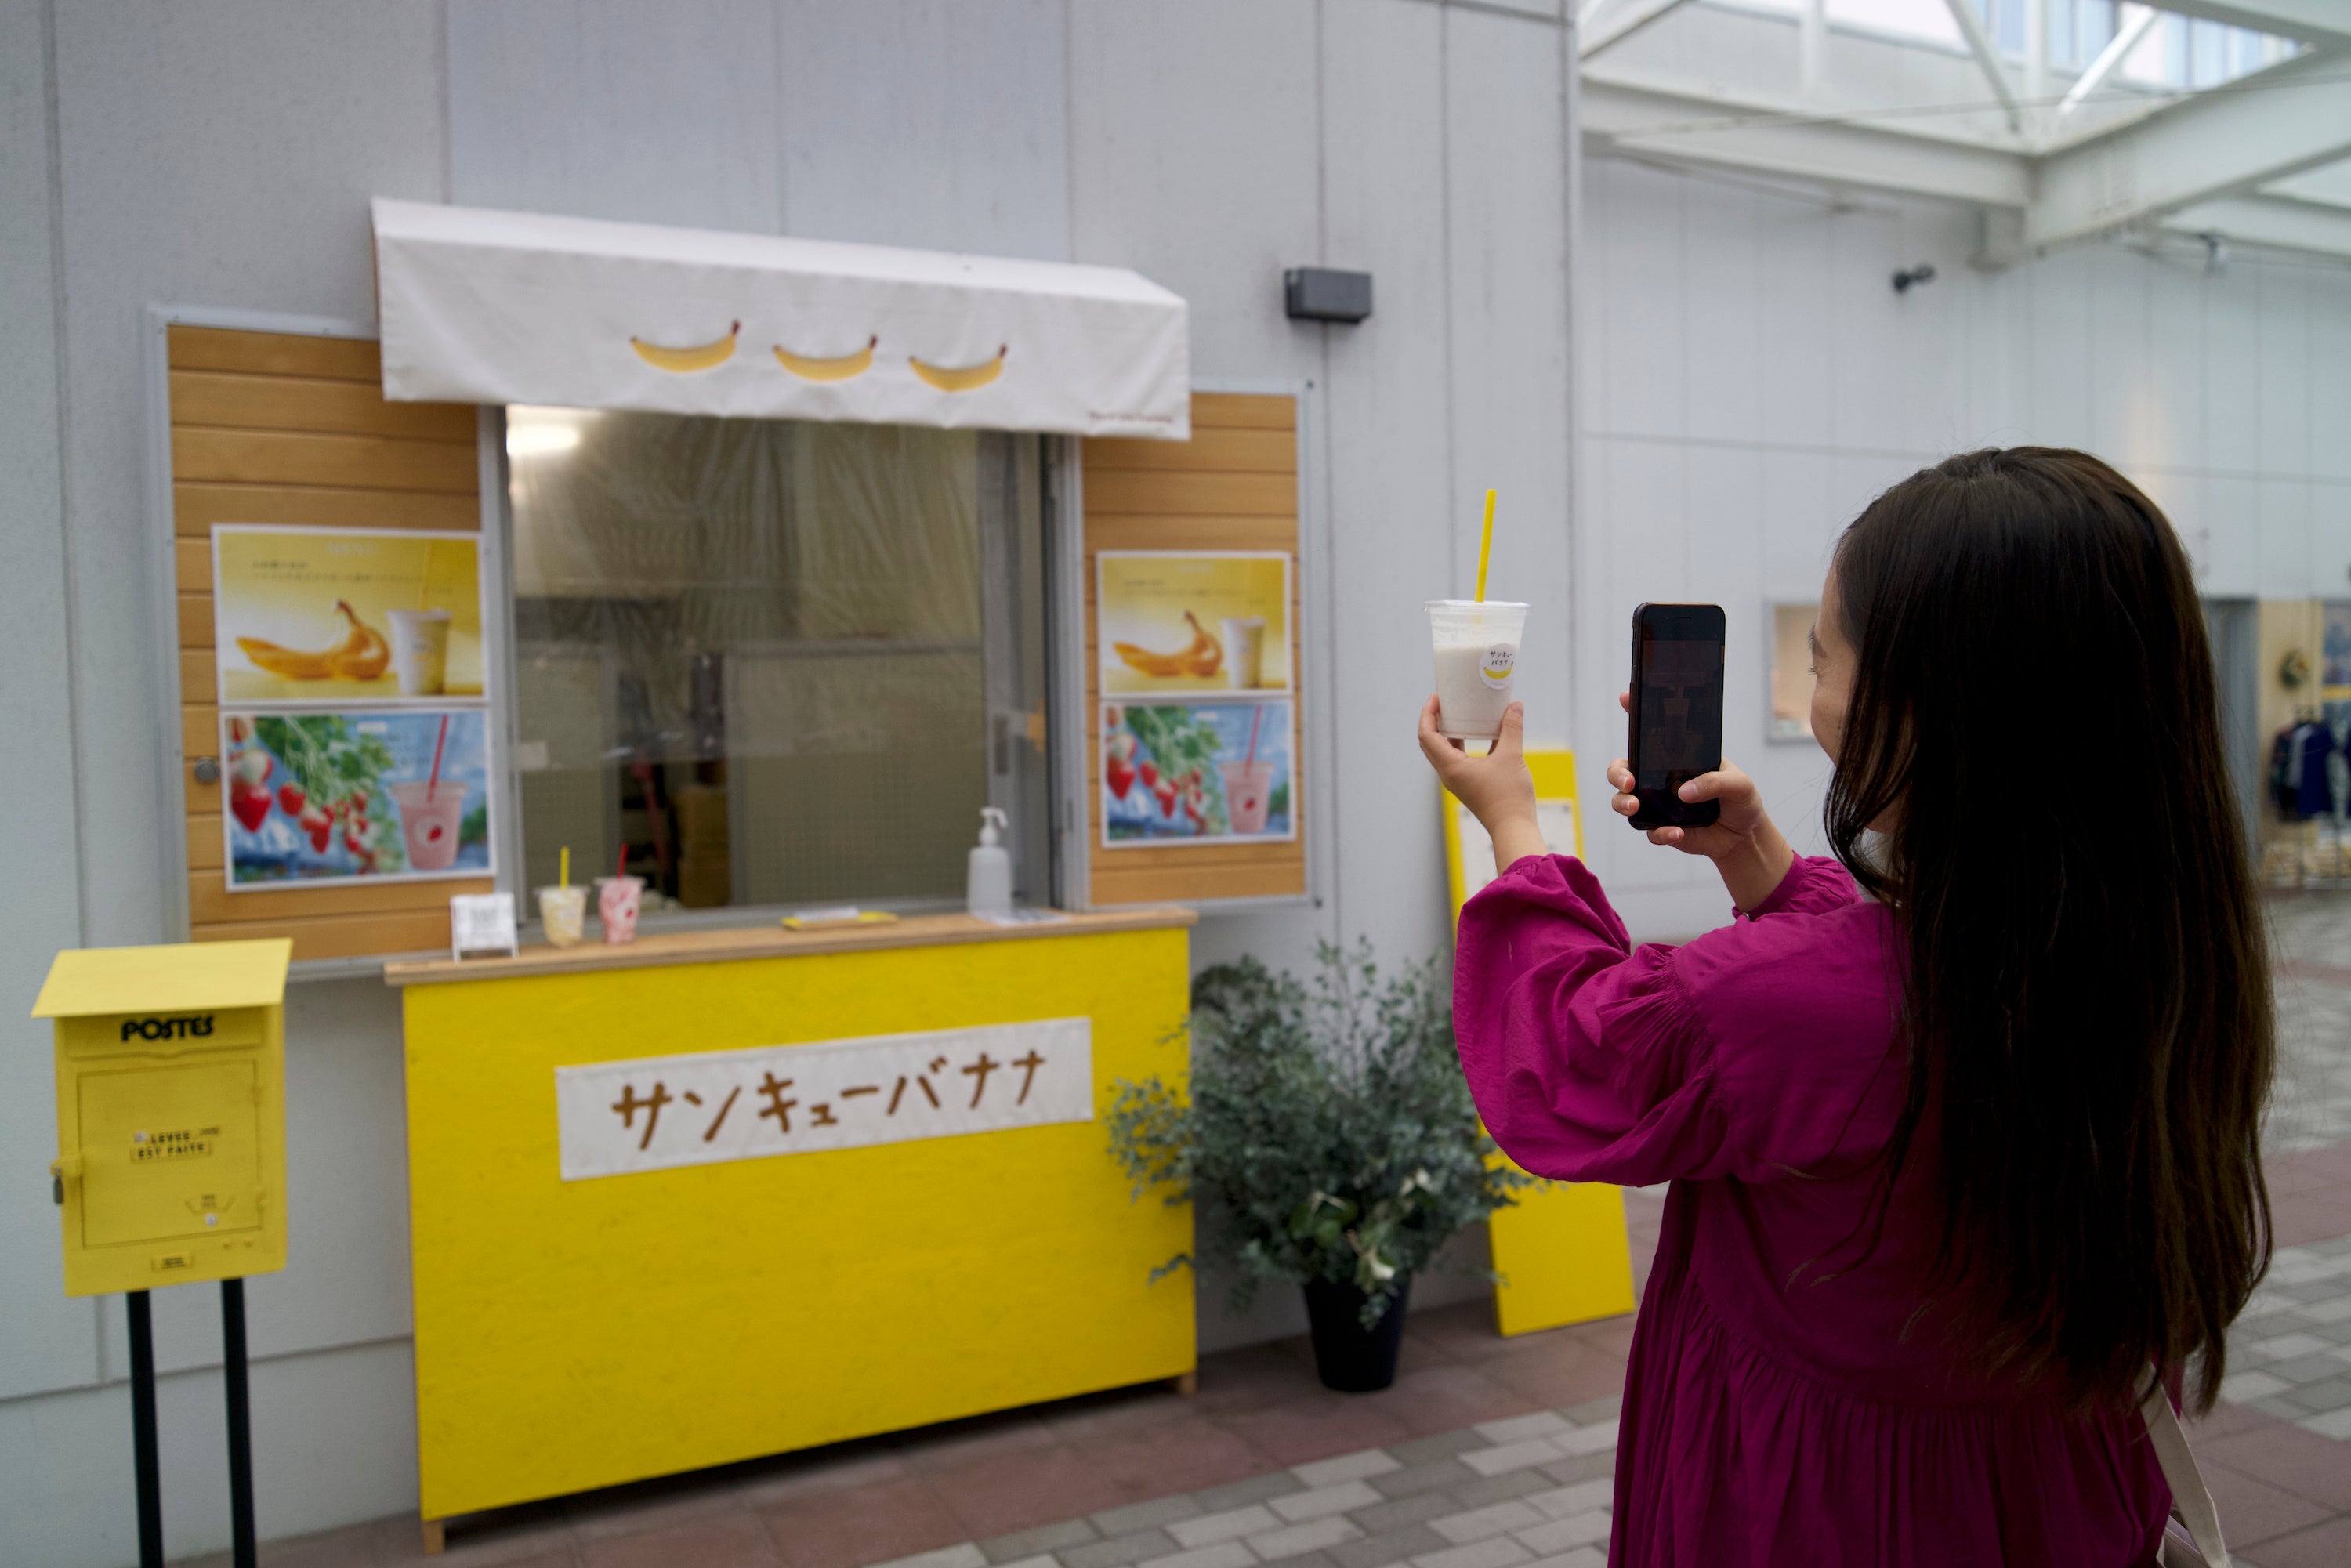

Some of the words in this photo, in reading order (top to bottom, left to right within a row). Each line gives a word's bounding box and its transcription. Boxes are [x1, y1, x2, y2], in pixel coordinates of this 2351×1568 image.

[121, 1015, 214, 1042] POSTES
[611, 1050, 1045, 1150] サンキューバナナ
